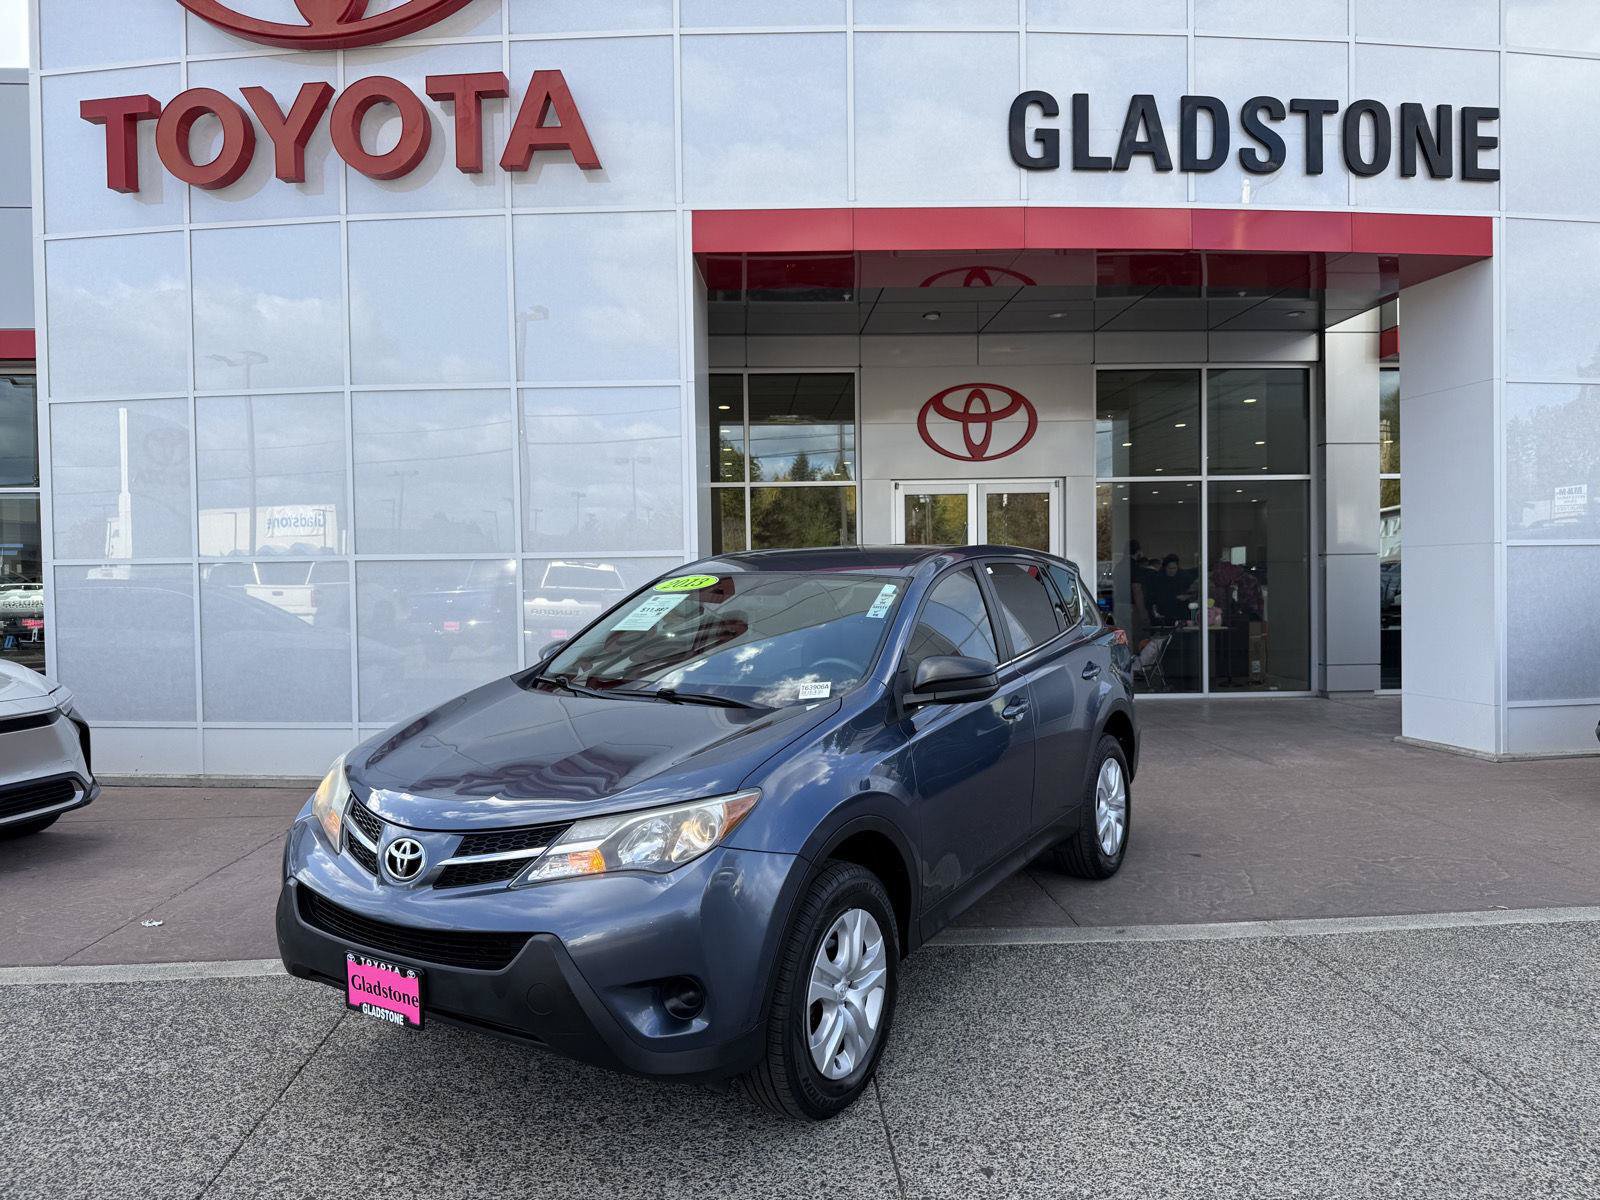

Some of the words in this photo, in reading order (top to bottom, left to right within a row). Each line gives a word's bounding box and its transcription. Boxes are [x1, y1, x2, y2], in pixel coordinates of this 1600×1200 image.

[80, 69, 602, 193] TOYOTA
[1008, 90, 1500, 181] GLADSTONE
[661, 576, 711, 589] 2013
[360, 957, 401, 974] TOYOTA
[350, 974, 419, 1008] Gladstone
[362, 1003, 405, 1026] GLADSTONE
